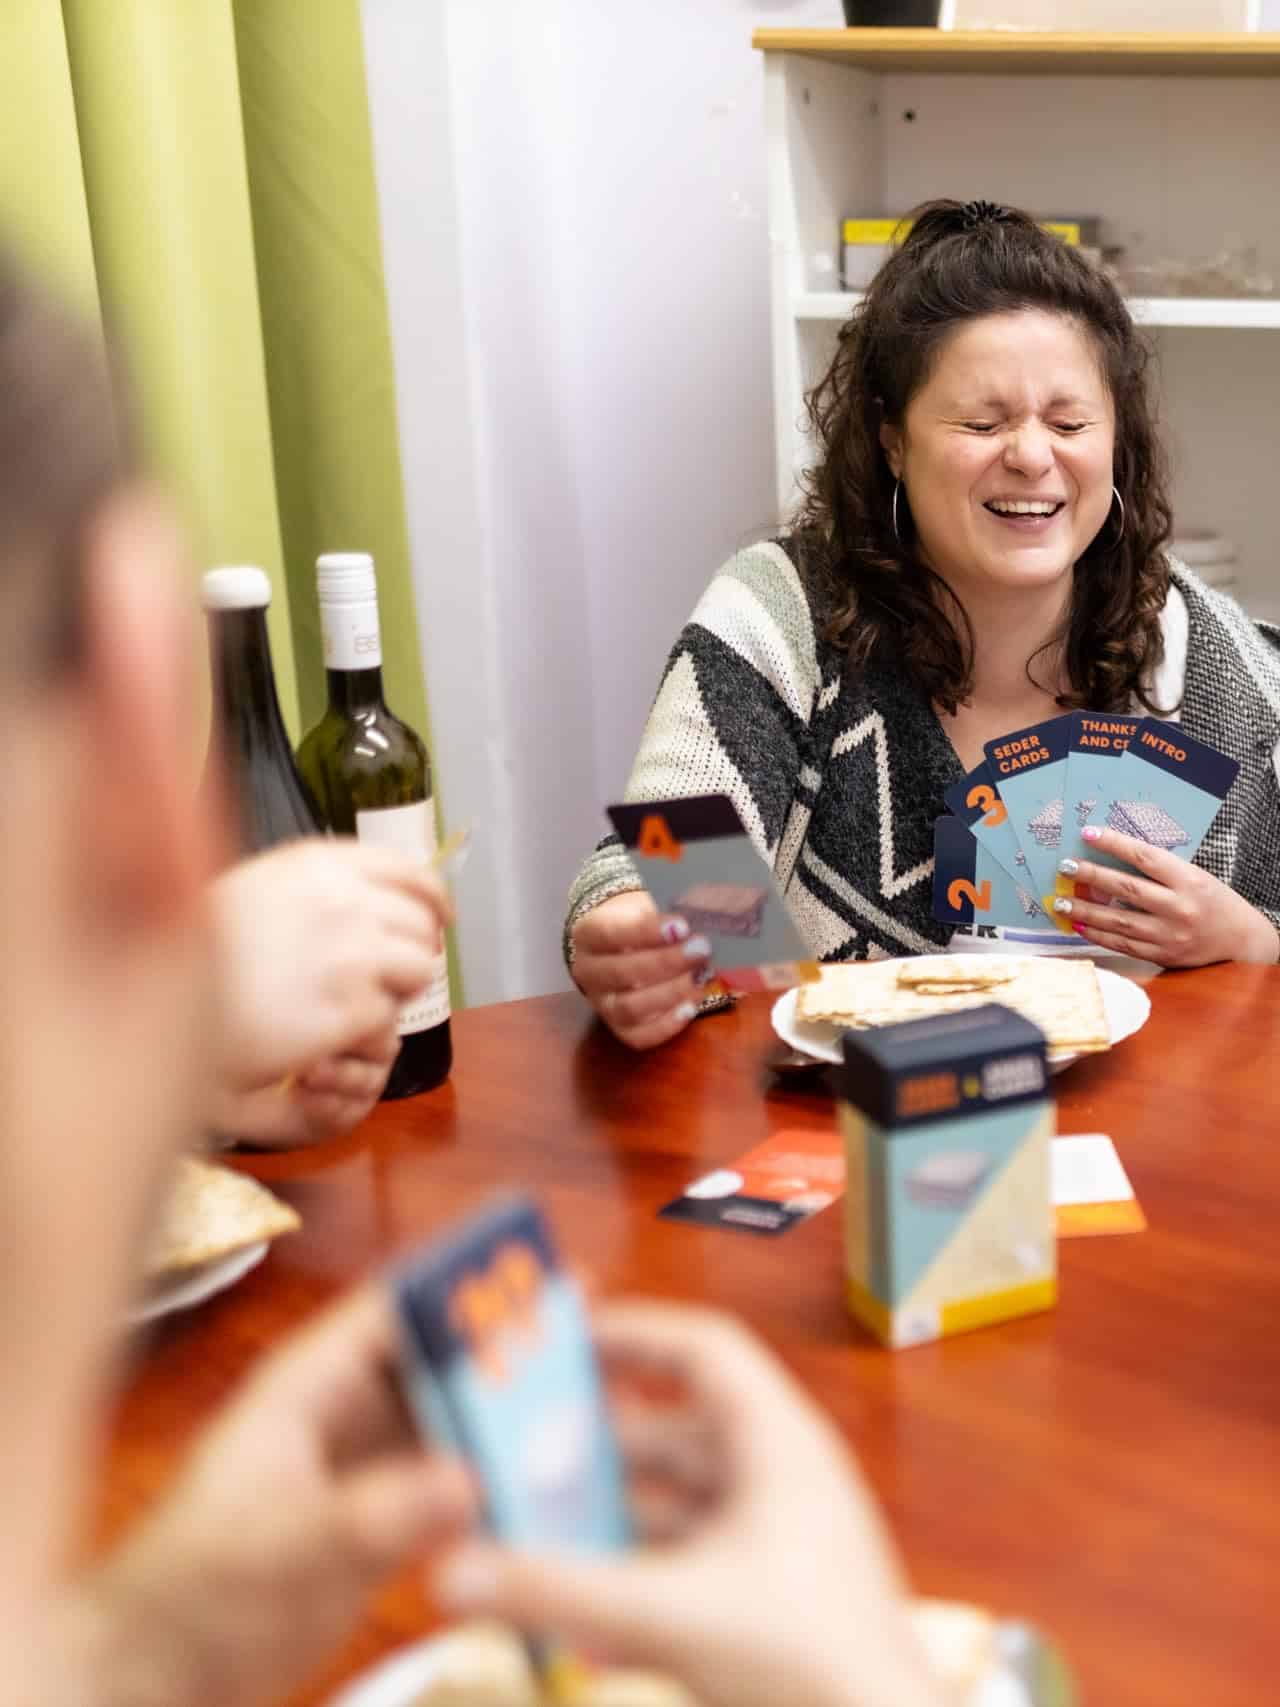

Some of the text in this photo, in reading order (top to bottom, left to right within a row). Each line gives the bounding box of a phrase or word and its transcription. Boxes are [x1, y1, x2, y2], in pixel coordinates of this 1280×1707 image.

[993, 735, 1040, 760] SEDER
[1080, 735, 1110, 748] AND
[1141, 731, 1186, 761] INTRO
[1000, 747, 1049, 773] CARDS
[966, 785, 1008, 828] 3
[947, 878, 992, 912] 2
